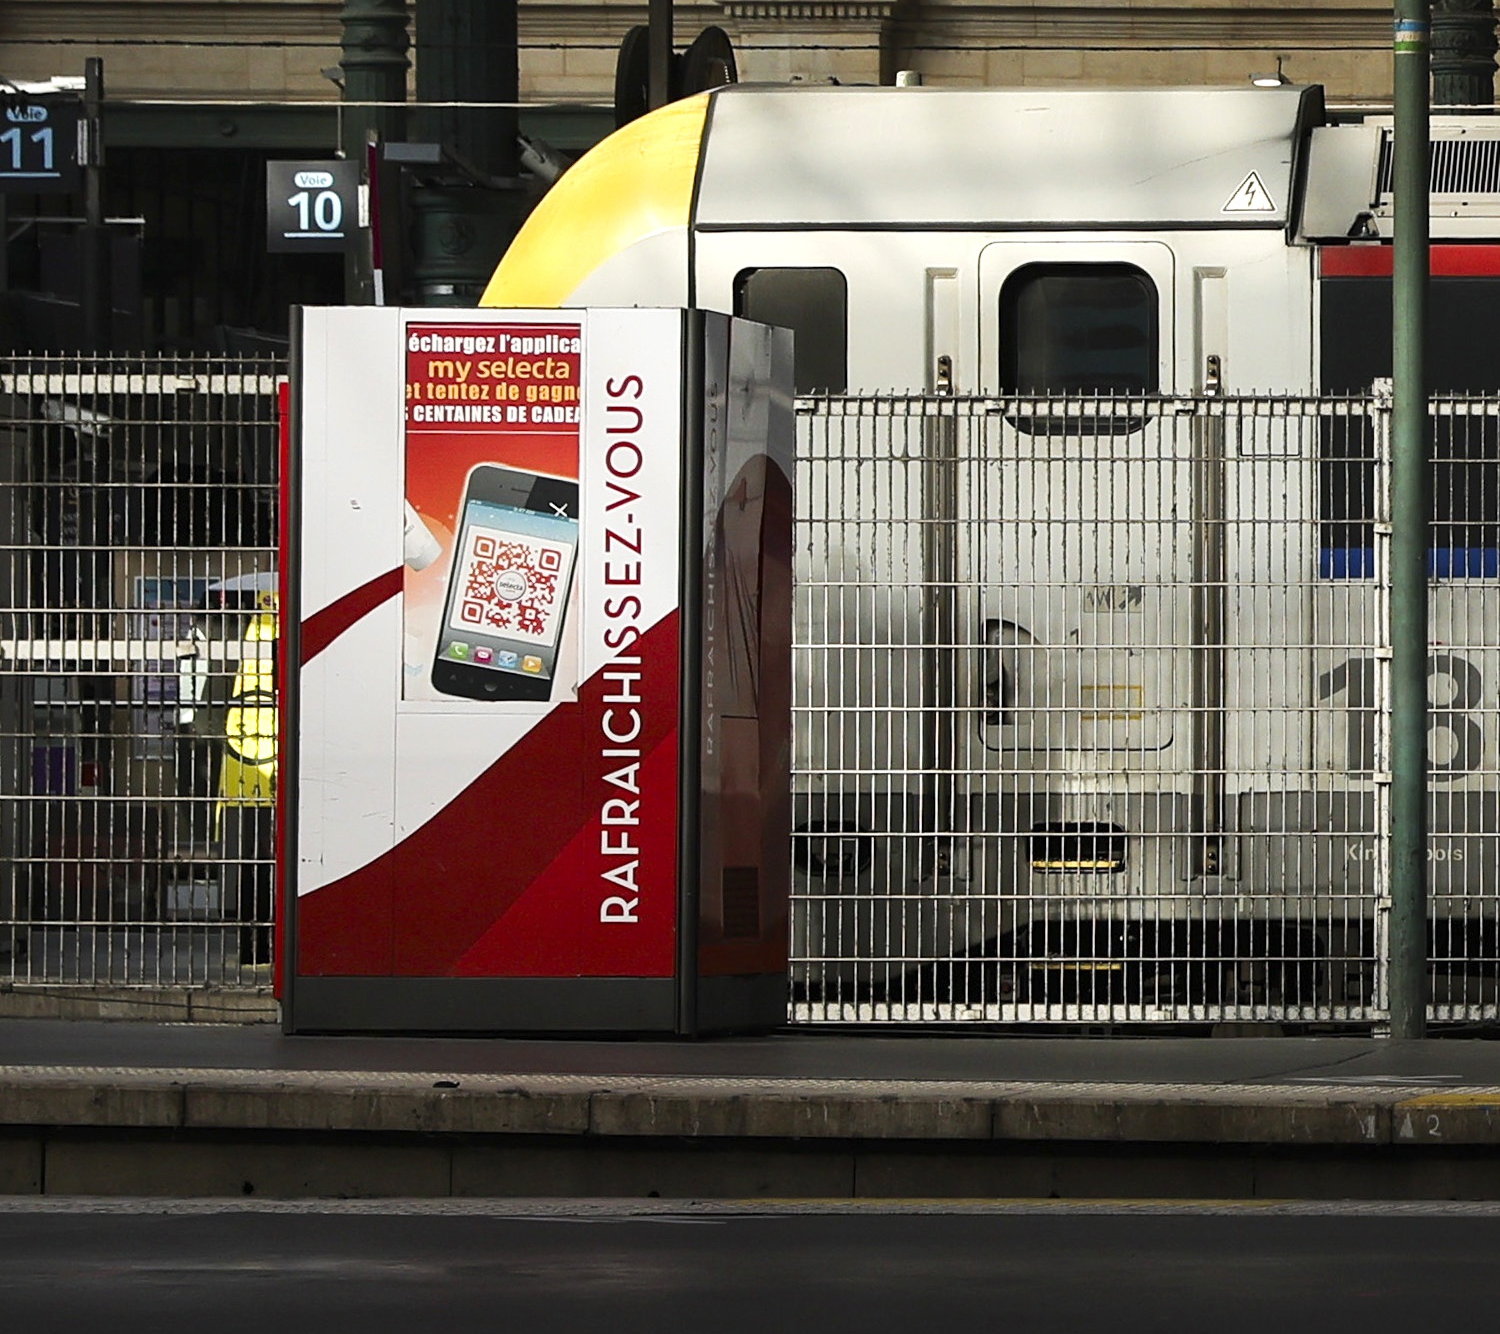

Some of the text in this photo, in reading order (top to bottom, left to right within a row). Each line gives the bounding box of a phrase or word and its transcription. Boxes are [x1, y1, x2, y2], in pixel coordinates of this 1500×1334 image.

[0, 127, 53, 169] 11
[299, 175, 327, 186] Voie
[287, 190, 342, 231] 10
[408, 333, 581, 355] échargez l'applica
[428, 357, 570, 382] my selecta
[427, 382, 490, 400] tentez
[496, 382, 521, 400] de
[526, 385, 580, 403] gagn
[413, 405, 503, 423] CENTAINES
[506, 406, 527, 423] DE
[600, 373, 645, 924] RAFRAICHISSEZ-VOUS
